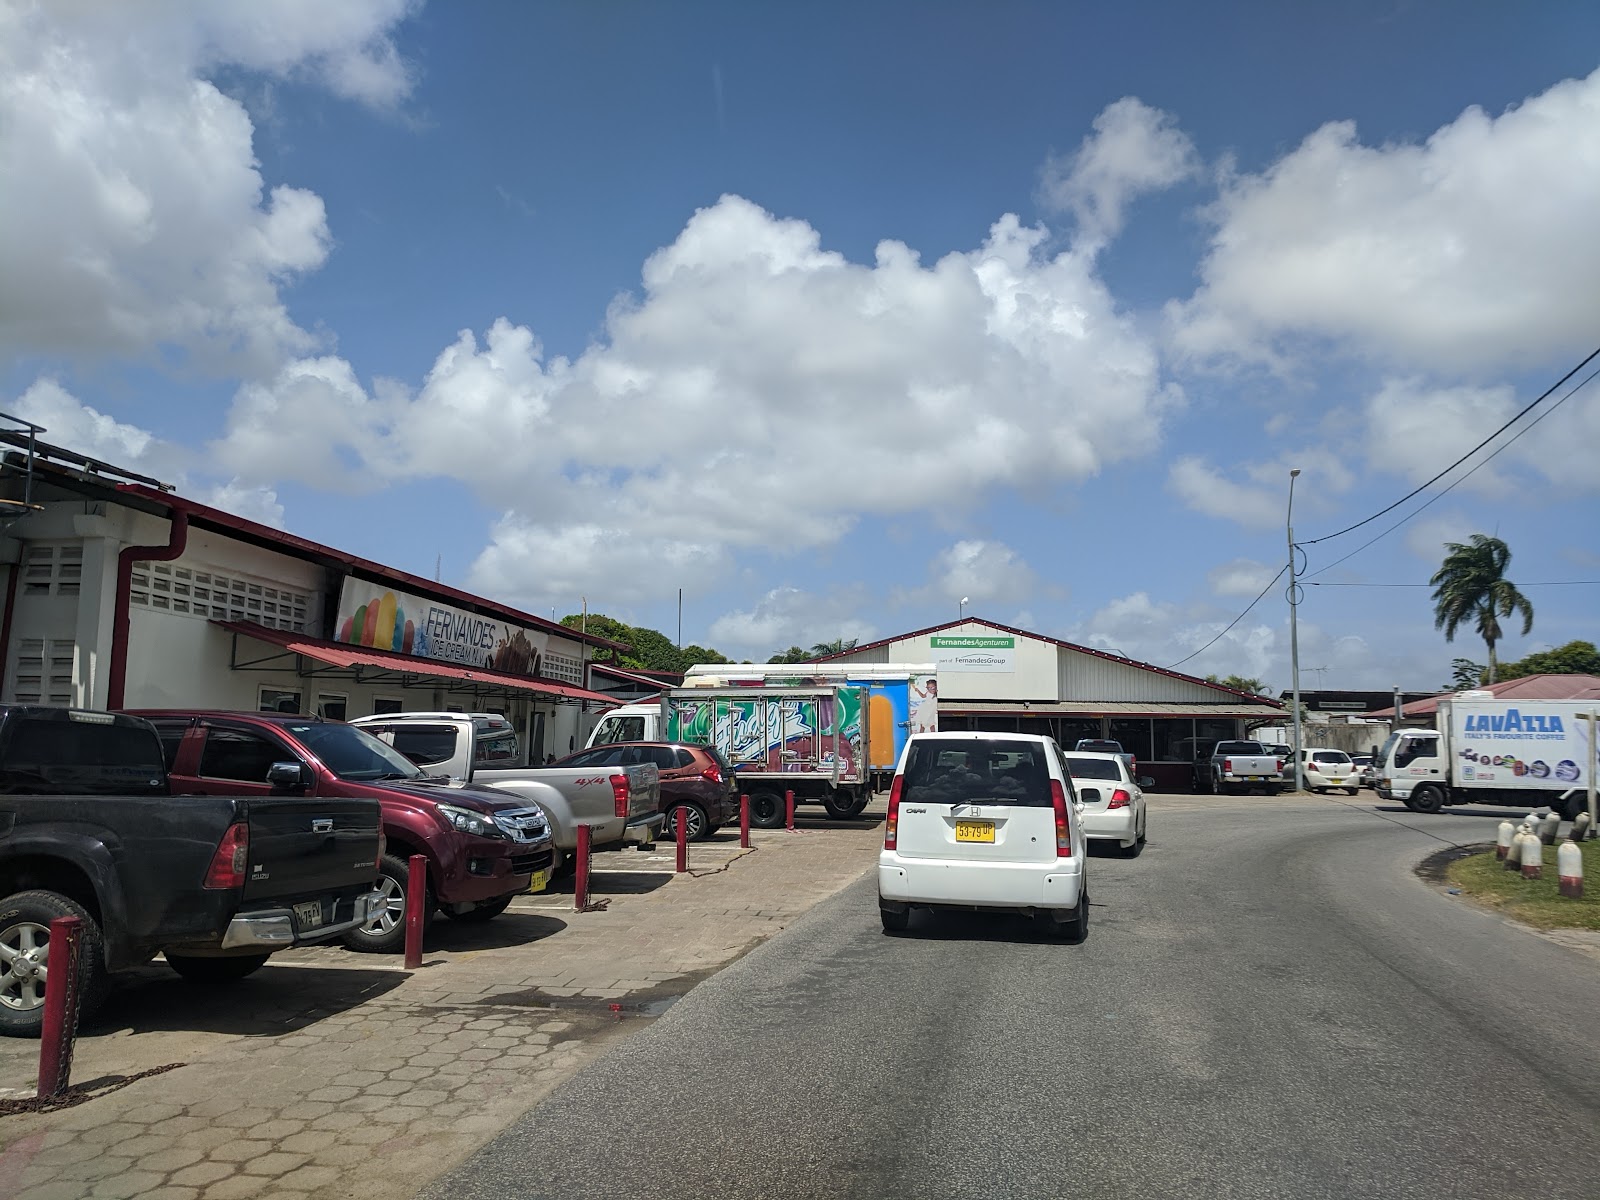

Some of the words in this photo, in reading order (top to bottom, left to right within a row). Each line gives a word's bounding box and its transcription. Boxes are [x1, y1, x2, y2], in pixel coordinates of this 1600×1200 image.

[426, 607, 496, 650] FERNANDES
[431, 638, 445, 657] ICE
[445, 642, 471, 661] CREAM
[937, 639, 1009, 647] FernandesAgenturen
[955, 657, 1006, 665] FernandesGroup
[959, 826, 981, 837] 53-79
[982, 822, 993, 834] UP
